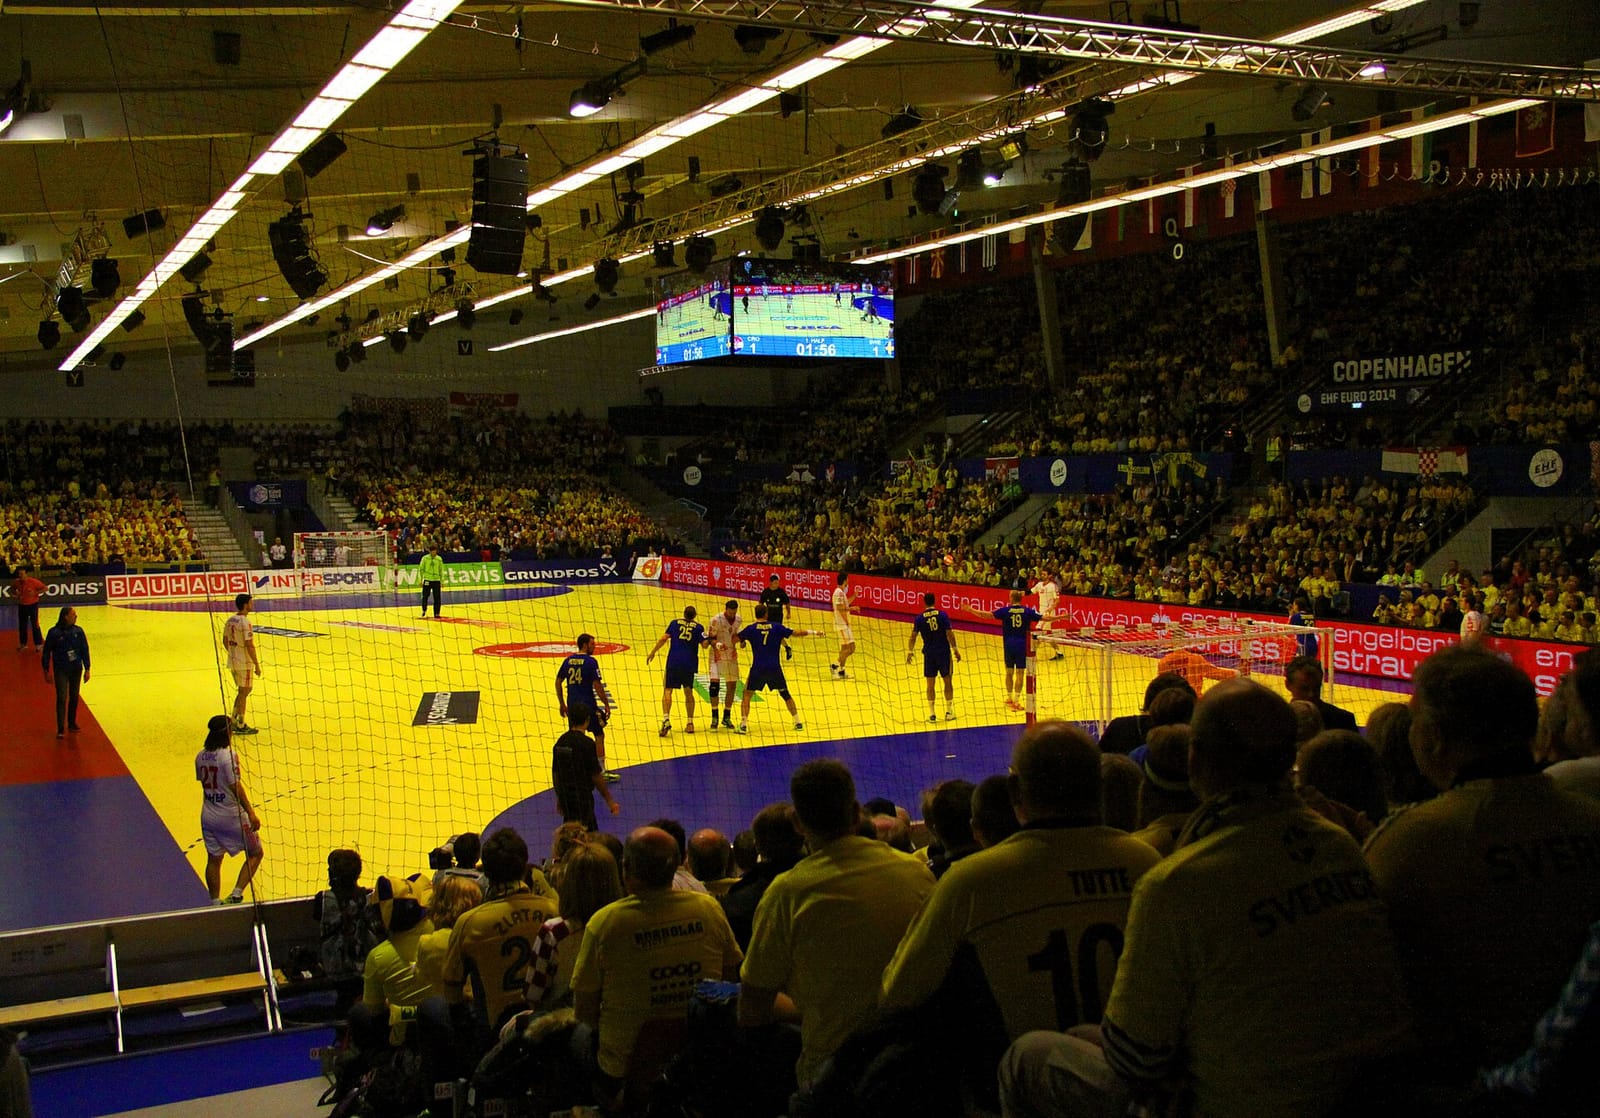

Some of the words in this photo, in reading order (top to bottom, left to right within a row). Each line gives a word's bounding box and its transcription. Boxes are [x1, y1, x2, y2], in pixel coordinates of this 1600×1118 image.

[1165, 218, 1179, 237] Q
[460, 342, 470, 352] V
[683, 347, 703, 361] 01:56
[750, 343, 756, 354] 1
[796, 343, 836, 356] 01:56
[873, 346, 879, 357] 1
[1333, 351, 1471, 383] COPENHAGEN
[1321, 393, 1339, 405] EHF
[1341, 391, 1367, 403] EURO
[1369, 389, 1396, 402] 2014
[1535, 460, 1557, 474] EHF
[673, 560, 708, 571] engelbert
[725, 564, 765, 578] engelbert
[504, 568, 599, 580] GRUNDFOS
[673, 572, 709, 586] strauss
[785, 571, 831, 586] engelbert
[111, 576, 245, 595] BAUHAUS
[725, 577, 765, 593] strauss
[785, 583, 831, 602] strauss
[854, 585, 925, 605] engelber
[926, 616, 938, 631] 18
[1010, 613, 1022, 628] 19
[679, 625, 692, 641] 25
[761, 631, 769, 645] 7
[568, 667, 582, 685] 24
[201, 765, 218, 789] 27
[1027, 923, 1123, 1031] 10
